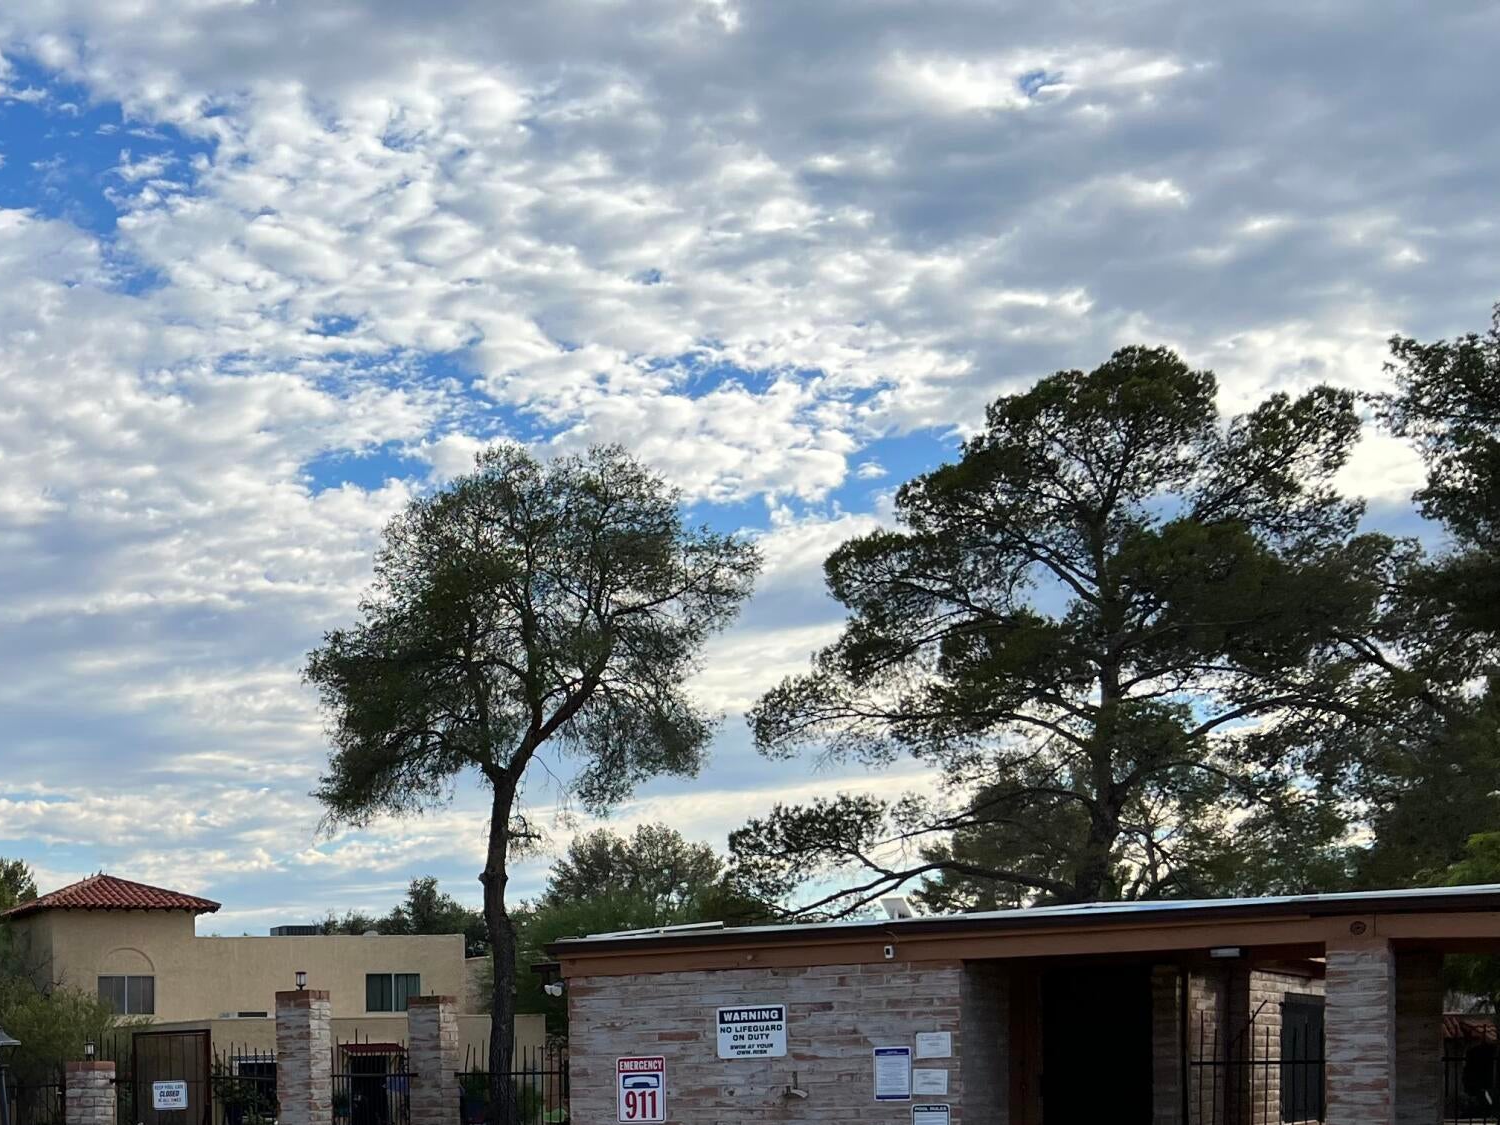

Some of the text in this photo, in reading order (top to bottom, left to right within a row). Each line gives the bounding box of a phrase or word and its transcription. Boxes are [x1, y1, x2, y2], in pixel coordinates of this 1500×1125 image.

[723, 1010, 779, 1021] WARNING
[735, 1024, 783, 1033] LIFEGUARD
[748, 1033, 770, 1041] DUTY
[620, 1060, 662, 1070] EMERGENCY
[625, 1090, 657, 1119] 911
